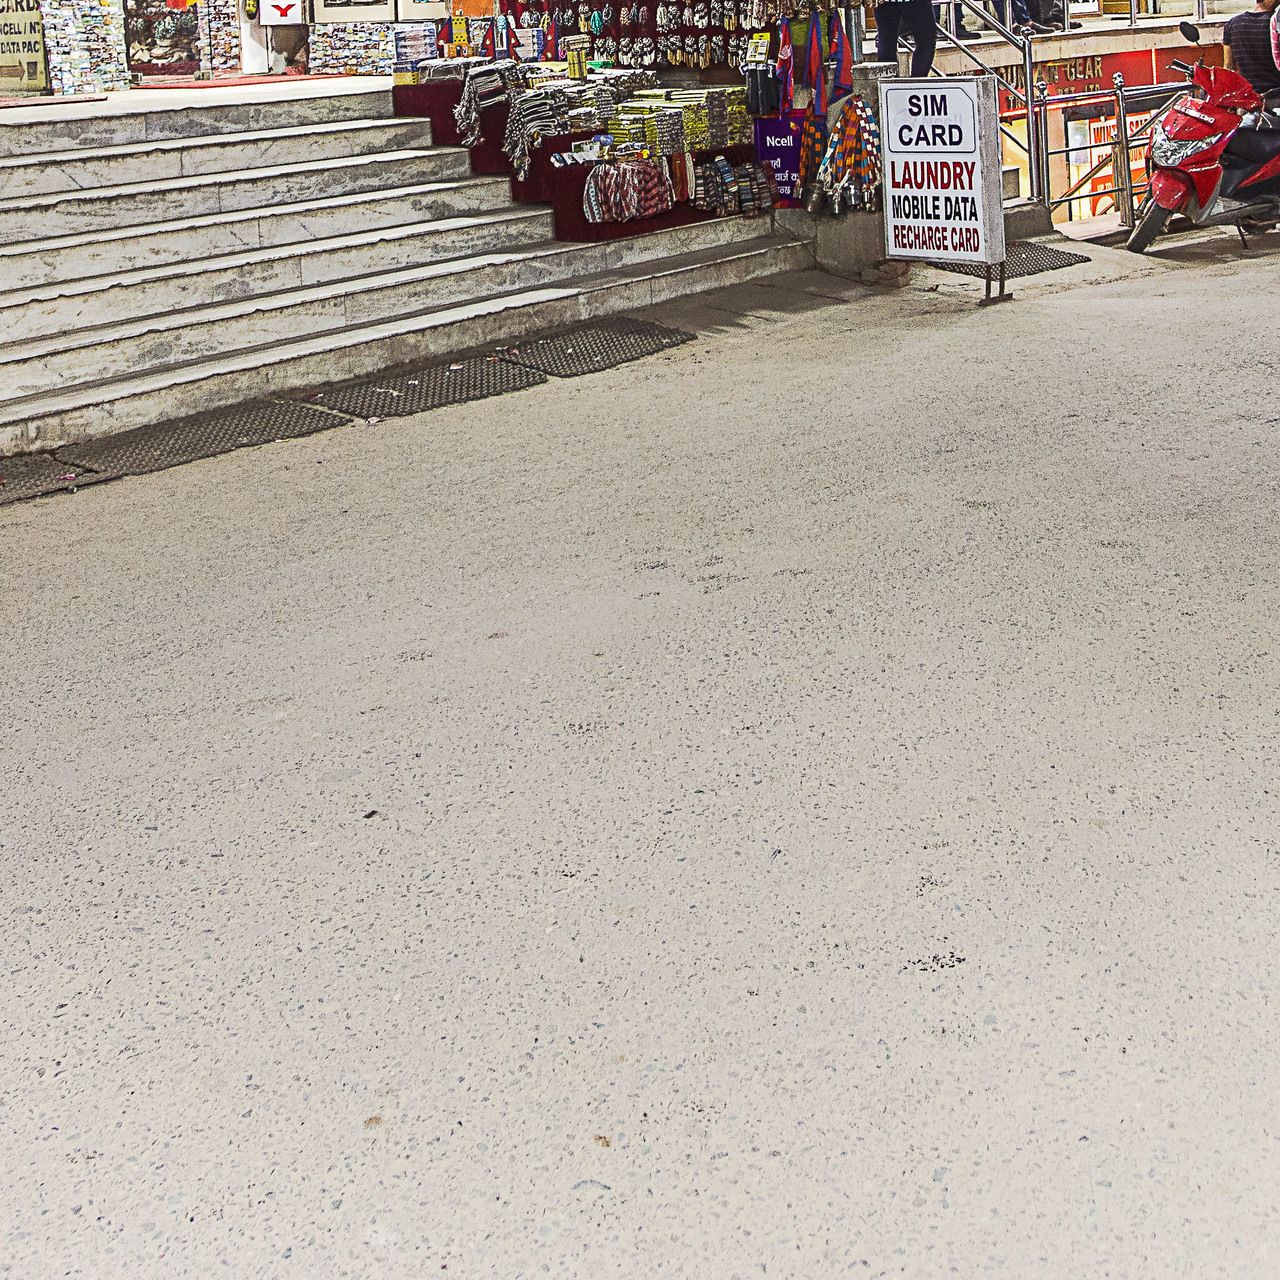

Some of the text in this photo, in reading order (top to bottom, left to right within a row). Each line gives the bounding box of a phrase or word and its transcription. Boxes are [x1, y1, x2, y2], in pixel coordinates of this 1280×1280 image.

[0, 41, 21, 54] DATA
[1065, 56, 1103, 81] GEAR
[908, 95, 948, 118] SIM
[766, 135, 793, 147] Ncell
[898, 124, 963, 147] CARD
[890, 160, 976, 192] LAUNDRY
[892, 195, 978, 222] MOBILE DATA
[893, 224, 981, 254] RECHARGE CARD
